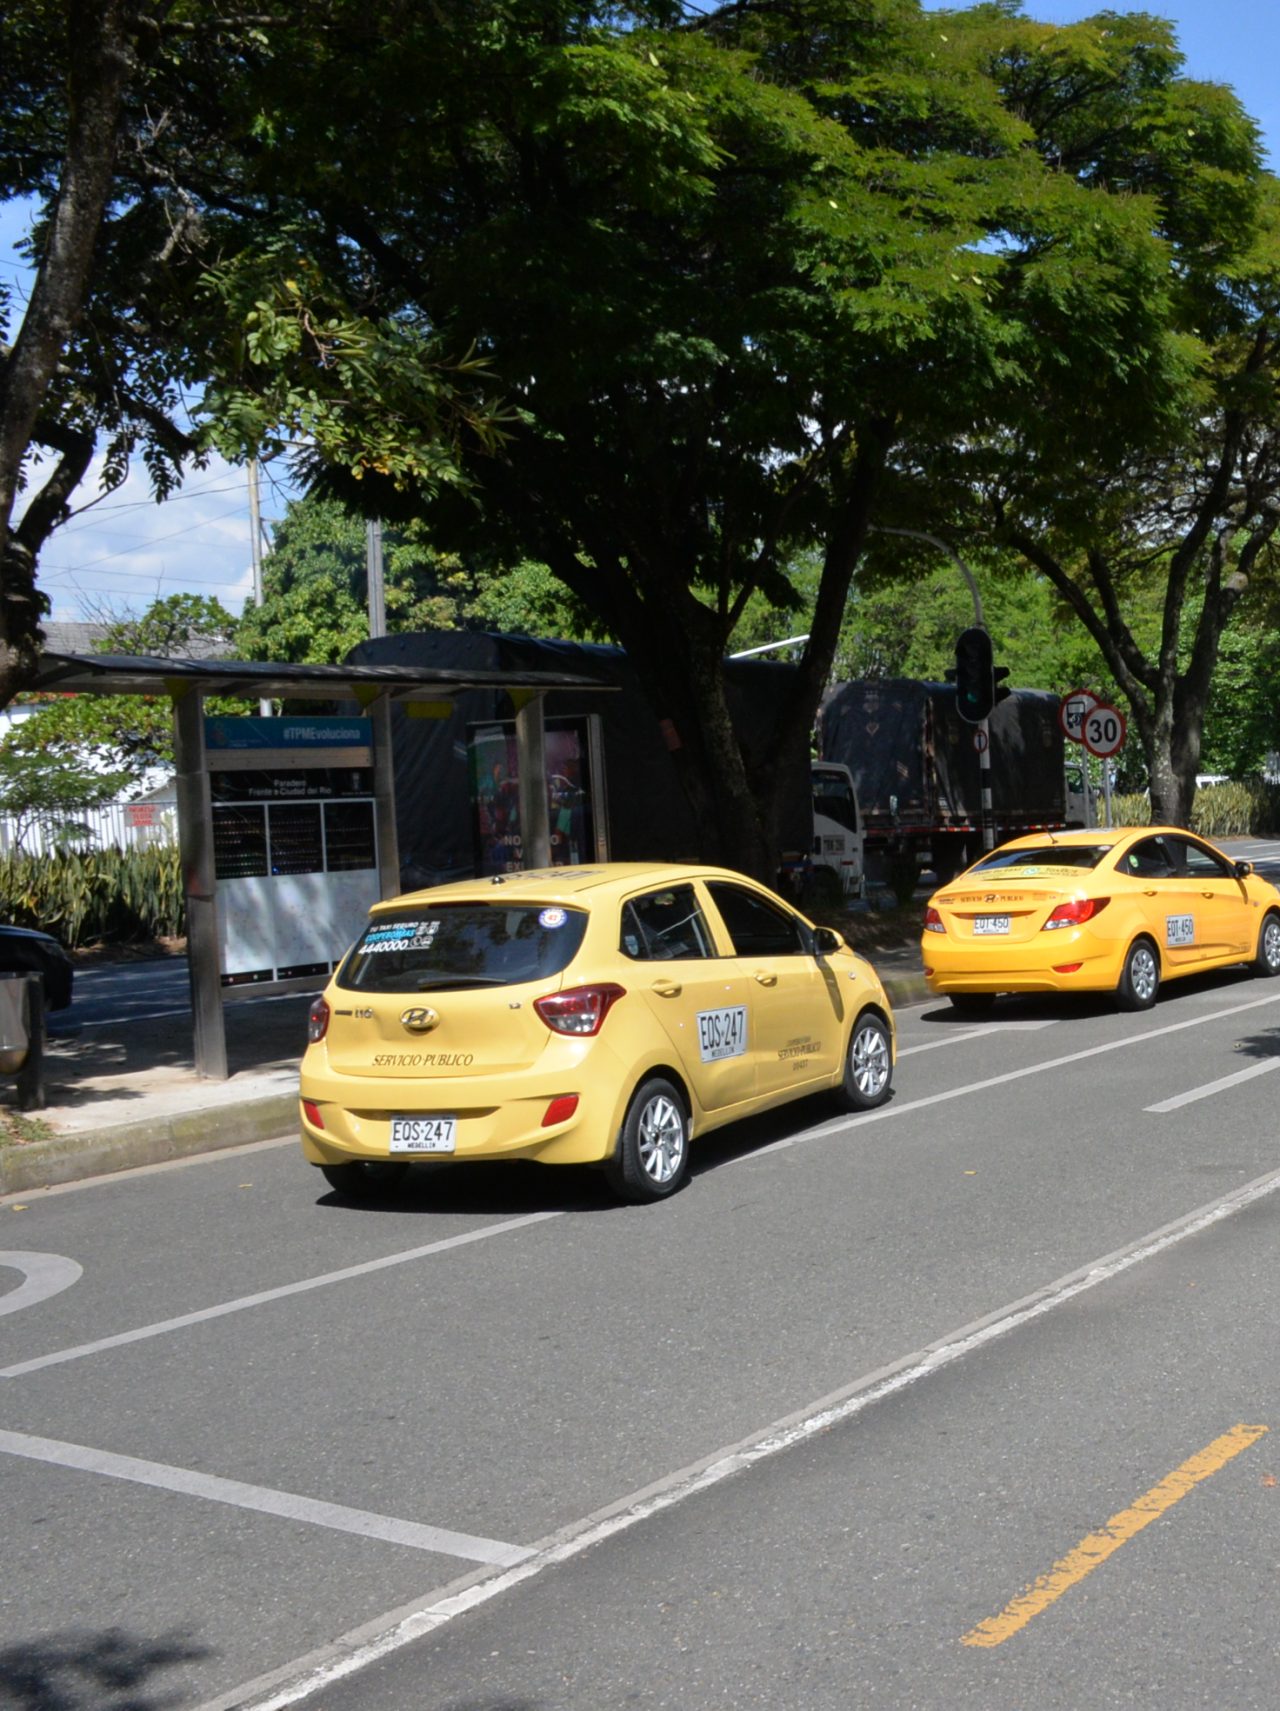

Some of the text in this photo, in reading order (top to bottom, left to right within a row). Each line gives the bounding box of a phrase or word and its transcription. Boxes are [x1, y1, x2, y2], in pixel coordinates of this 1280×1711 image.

[283, 727, 361, 740] #TPMEvoluciona
[1089, 718, 1118, 743] 30
[273, 779, 307, 787] Paradero
[248, 788, 273, 796] Frente
[279, 787, 306, 796] Ciudad
[358, 939, 409, 954] 4440000
[372, 1053, 474, 1067] SERVICIO PUBLICO
